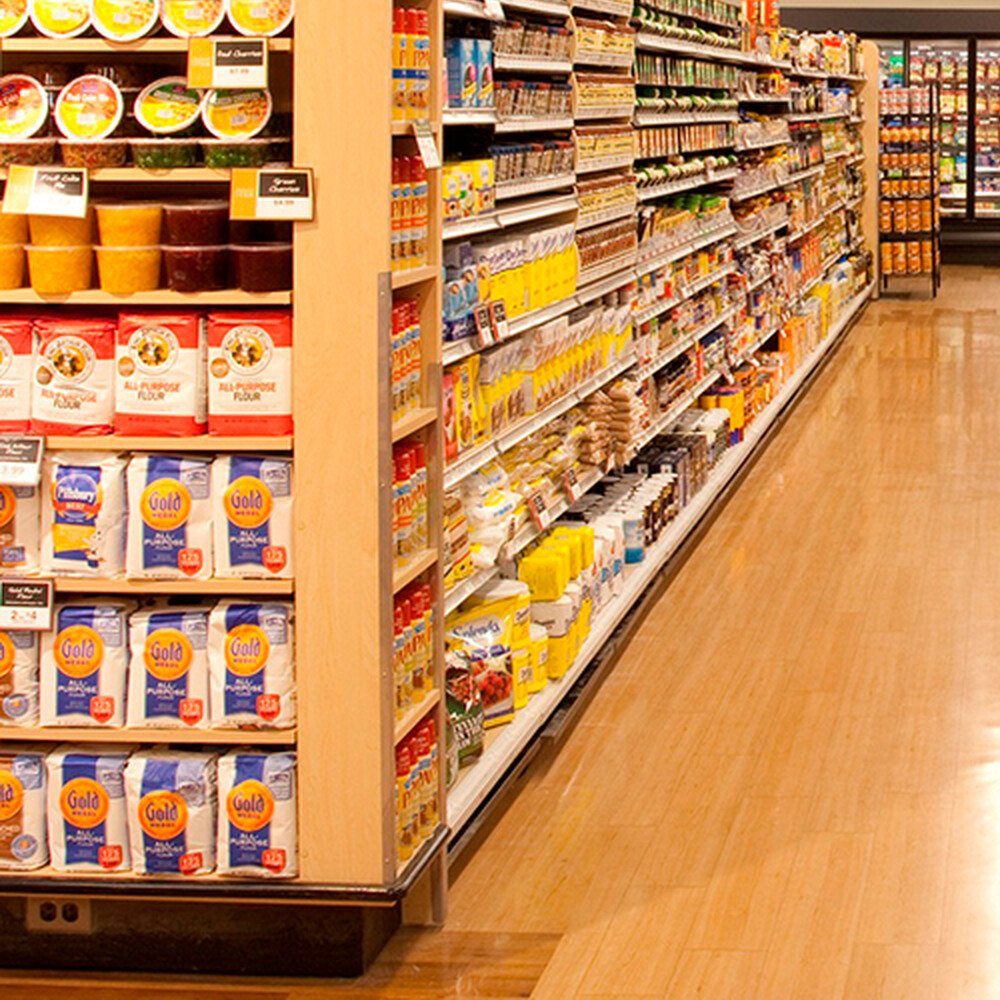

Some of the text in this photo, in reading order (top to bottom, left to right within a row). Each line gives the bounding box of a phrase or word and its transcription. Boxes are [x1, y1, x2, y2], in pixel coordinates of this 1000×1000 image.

[123, 380, 180, 392] ALL-PURPOSE
[138, 392, 166, 400] FLOUR
[218, 382, 277, 393] ALL-PURPOSE
[54, 398, 81, 410] FLOUR
[233, 392, 261, 401] FLOUR
[58, 486, 96, 504] Pillsbury
[148, 490, 181, 511] Gold
[231, 489, 263, 510] Gold
[61, 638, 95, 658] Gold
[150, 641, 182, 662] Gold
[230, 636, 261, 658] Gold
[68, 790, 99, 810] Gold
[232, 793, 265, 813] Gold
[145, 801, 178, 822] Gold
